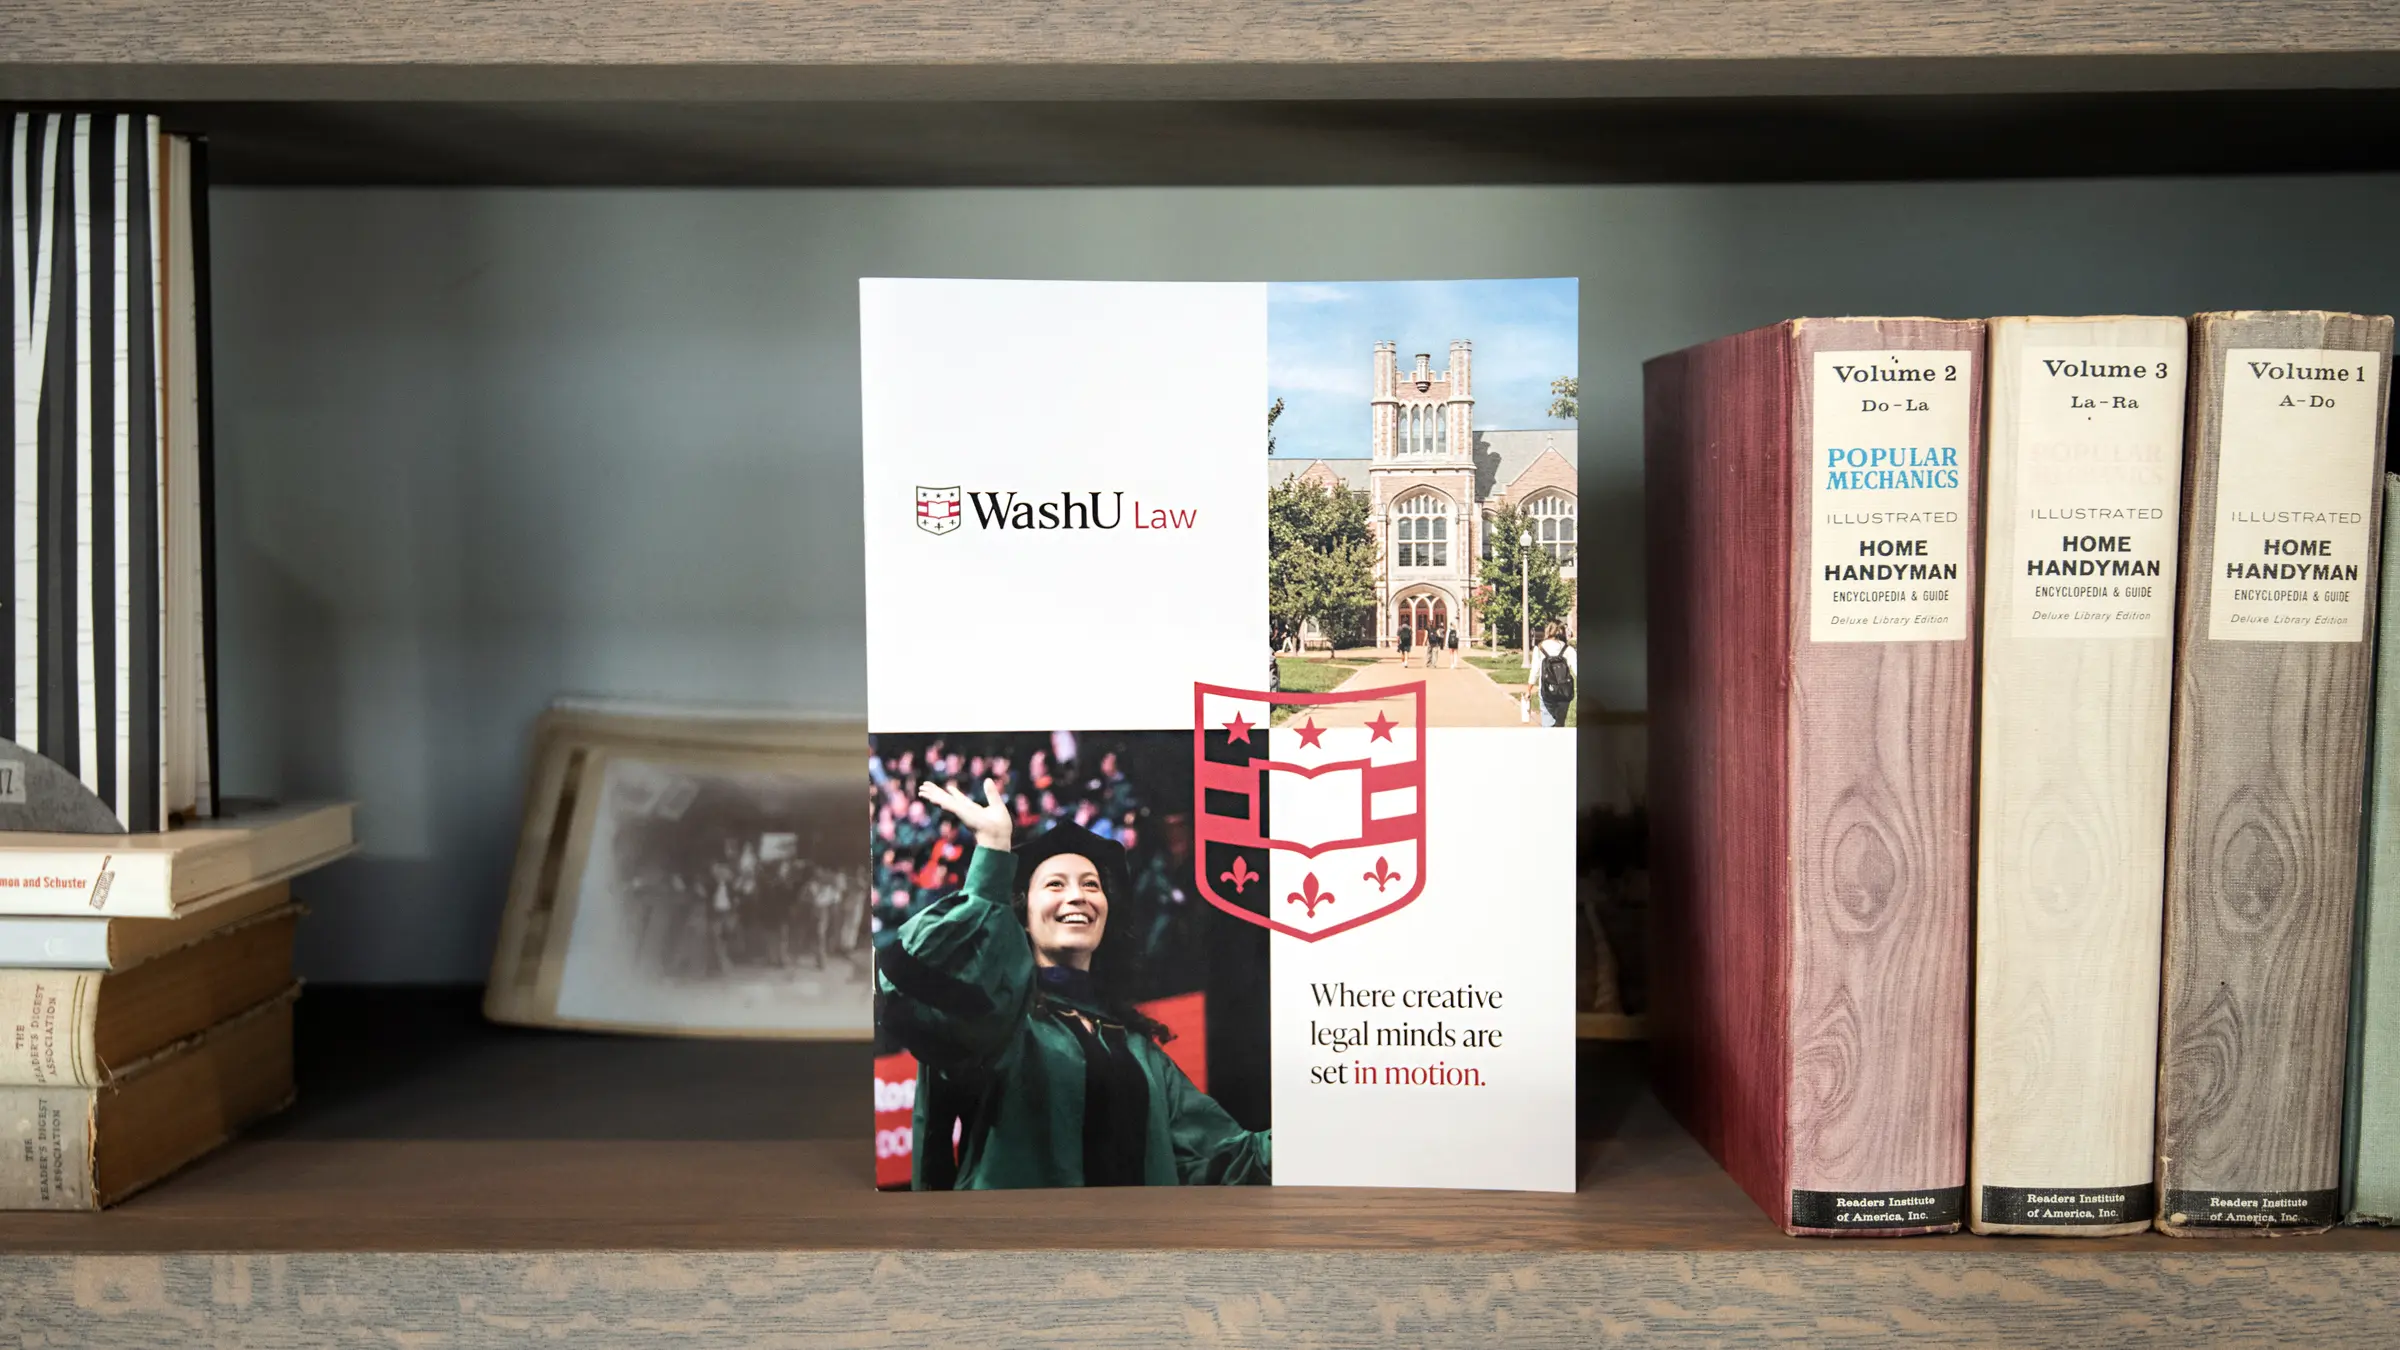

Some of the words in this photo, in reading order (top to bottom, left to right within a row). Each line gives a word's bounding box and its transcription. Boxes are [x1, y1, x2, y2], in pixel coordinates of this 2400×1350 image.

[1833, 365, 1936, 383] Volume
[1944, 365, 1957, 381] 2
[2043, 359, 2147, 378] Volume
[2155, 362, 2168, 379] 3
[2248, 361, 2349, 382] Volume
[2356, 365, 2365, 382] 1
[1828, 447, 1958, 468] POPULAR
[1826, 469, 1959, 490] MECHANICS
[967, 491, 1124, 530] WashU
[1134, 501, 1198, 529] Law
[1827, 512, 1958, 525] ILLUSTRATED
[2030, 508, 2163, 520] ILLUSTRATED
[2232, 511, 2362, 524] ILLUSTRATED
[1859, 540, 1928, 557] HOME
[2063, 535, 2132, 552] HOME
[2264, 539, 2332, 557] HOME
[1824, 563, 1957, 581] HANDYMAN
[2027, 560, 2160, 577] HANDYMAN
[2226, 563, 2359, 581] HANDYMAN
[1833, 590, 1906, 603] ENCYCLOPEDIA
[1911, 591, 1918, 601] &
[1923, 590, 1949, 601] GUIDE
[2035, 586, 2108, 598] ENCYCLOPEDIA
[2113, 587, 2120, 597] &
[2125, 586, 2152, 597] GUIDE
[2234, 589, 2308, 602] ENCYCLOPEDIA
[2312, 590, 2320, 602] &
[2324, 590, 2350, 602] GUIDE
[1830, 615, 1868, 625] Deluxe
[1873, 615, 1911, 627] Library
[1914, 614, 1949, 625] Edition
[2032, 611, 2070, 621] Deluxe
[2074, 611, 2112, 622] Library
[2116, 611, 2151, 621] Edition
[2230, 614, 2269, 624] Deluxe
[2274, 614, 2311, 626] Library
[2314, 614, 2348, 625] Edition
[23, 877, 41, 888] and
[44, 876, 86, 889] Schuster
[1310, 982, 1396, 1008] Where
[1402, 984, 1503, 1009] creative
[31, 983, 44, 1029] DIGEST
[16, 1024, 25, 1050] THE
[45, 997, 56, 1076] ASSOCIATION
[1310, 1020, 1369, 1053] legal
[1377, 1021, 1456, 1047] minds
[1462, 1028, 1503, 1048] are
[1310, 1062, 1349, 1084] set
[1354, 1060, 1377, 1084] in
[1385, 1061, 1487, 1086] motion.
[38, 1099, 47, 1140] DIGEST
[25, 1138, 34, 1162] THE
[53, 1109, 63, 1190] ASSOCIATION
[1836, 1197, 1885, 1207] Readers
[1888, 1196, 1935, 1207] Institute
[2027, 1194, 2075, 1204] Readers
[2079, 1194, 2125, 1203] Institute
[2210, 1198, 2258, 1208] Readers
[2262, 1198, 2308, 1208] Institute
[1836, 1212, 1850, 1222] of
[1852, 1212, 1904, 1222] America,
[1908, 1211, 1928, 1220] Inc.
[2027, 1208, 2040, 1218] of
[2042, 1208, 2095, 1218] America,
[2098, 1208, 2118, 1217] Inc.
[2209, 1213, 2222, 1221] of
[2225, 1213, 2277, 1222] America,
